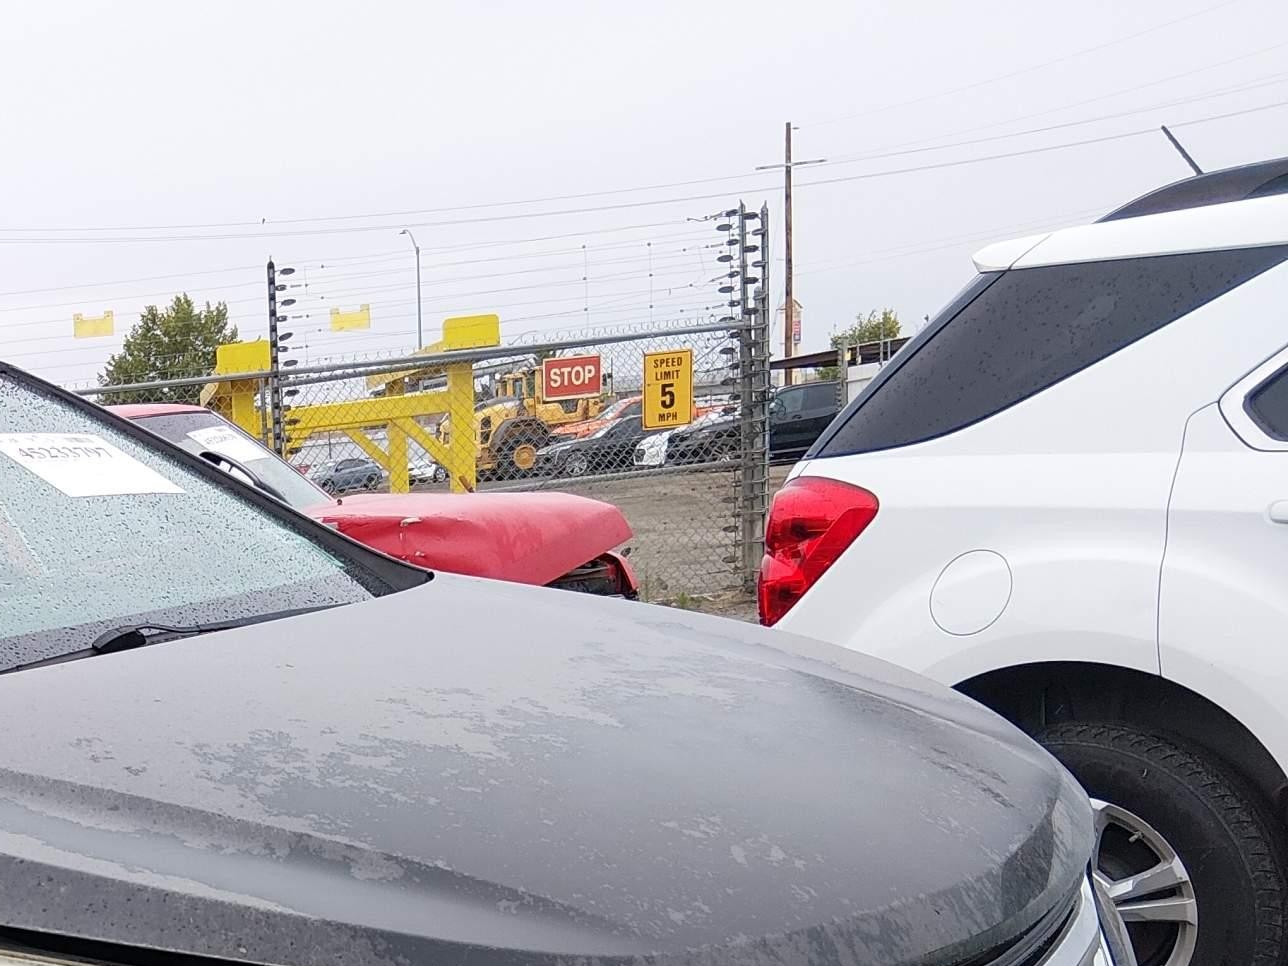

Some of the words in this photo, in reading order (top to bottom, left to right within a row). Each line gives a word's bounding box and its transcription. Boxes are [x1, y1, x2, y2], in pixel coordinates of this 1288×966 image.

[653, 357, 682, 368] SPEED
[550, 365, 595, 387] STOP
[655, 370, 680, 381] LIMIT
[660, 383, 675, 410] 5
[658, 411, 677, 422] MPH
